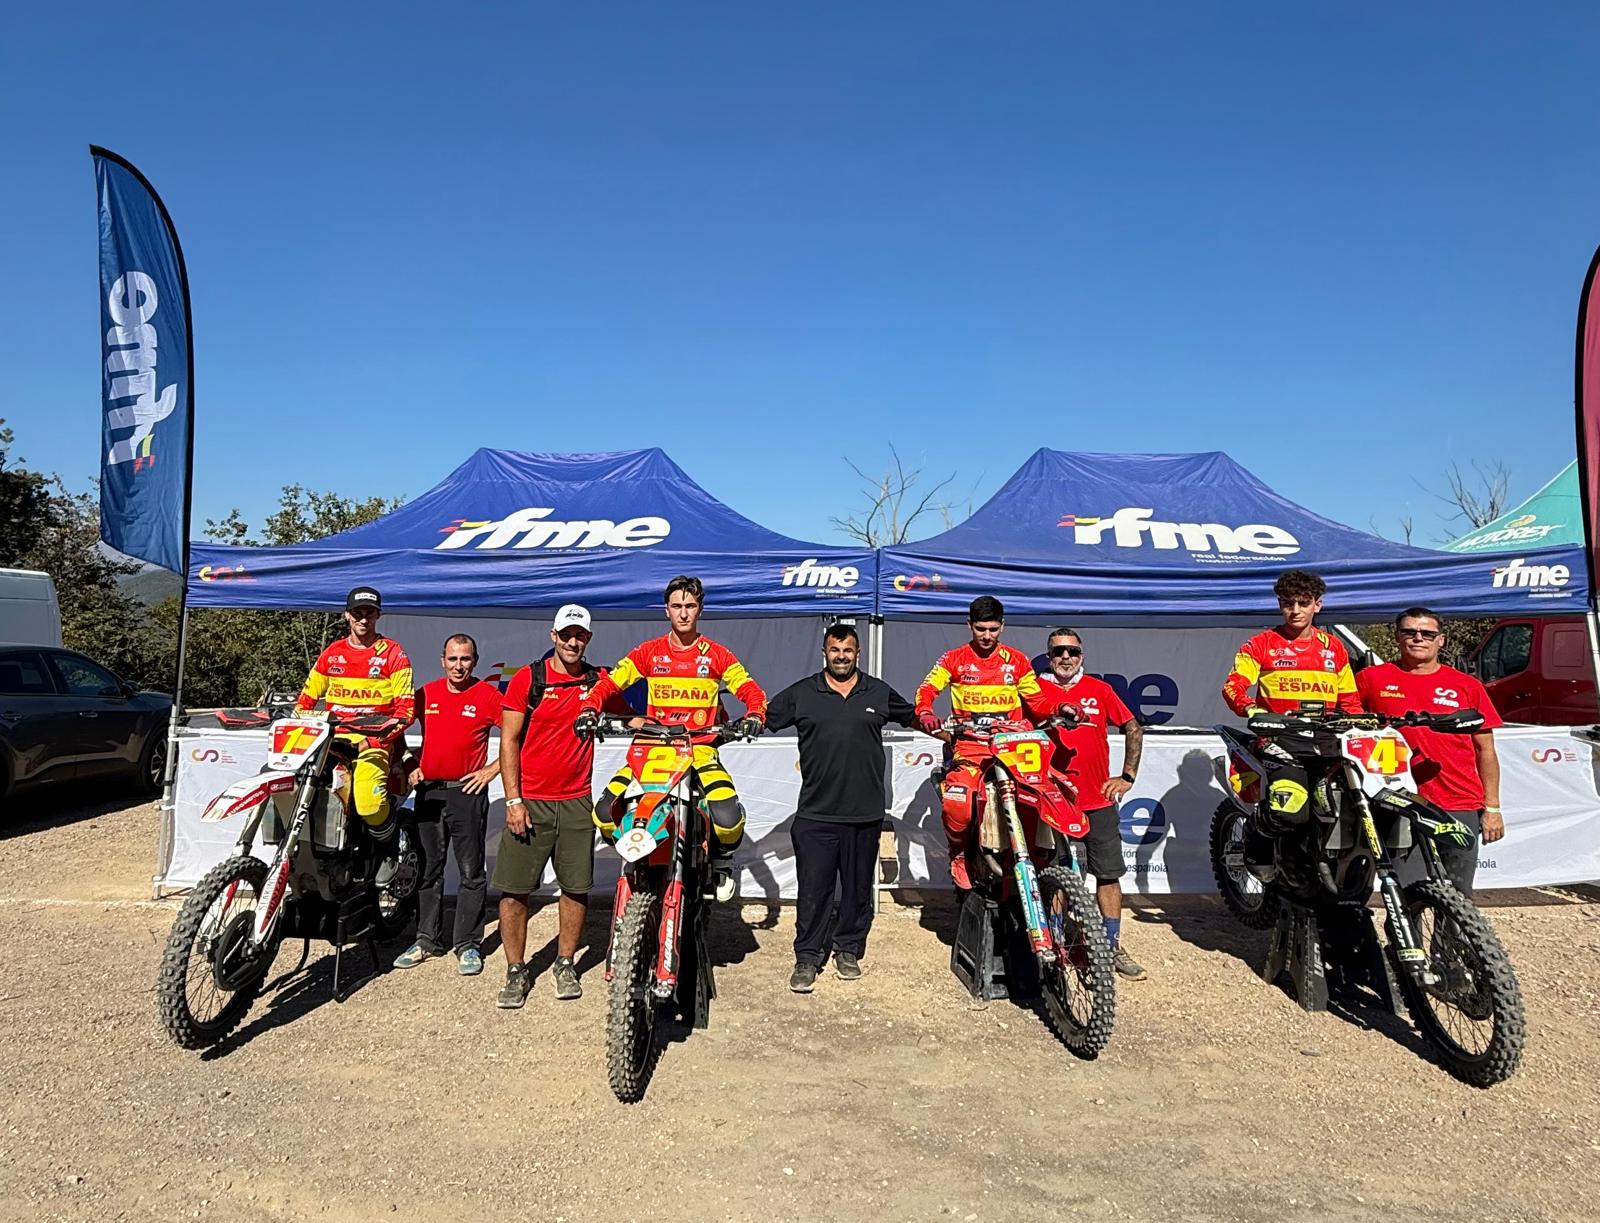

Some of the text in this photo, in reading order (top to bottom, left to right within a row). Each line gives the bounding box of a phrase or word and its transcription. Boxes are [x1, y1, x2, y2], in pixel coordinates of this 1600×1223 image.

[107, 270, 178, 465] rfme
[433, 507, 672, 550] rfme
[1074, 507, 1302, 556] rfme
[781, 558, 860, 588] rfme
[1492, 559, 1570, 588] rfme
[654, 687, 710, 700] ESPAÑA
[962, 695, 1015, 706] ESPAÑA
[1278, 681, 1335, 695] ESPAÑA
[281, 726, 305, 753] 1
[639, 746, 677, 783] 2
[1016, 742, 1042, 773] 3
[1366, 738, 1399, 774] 4
[1384, 892, 1407, 949] DUNLOP
